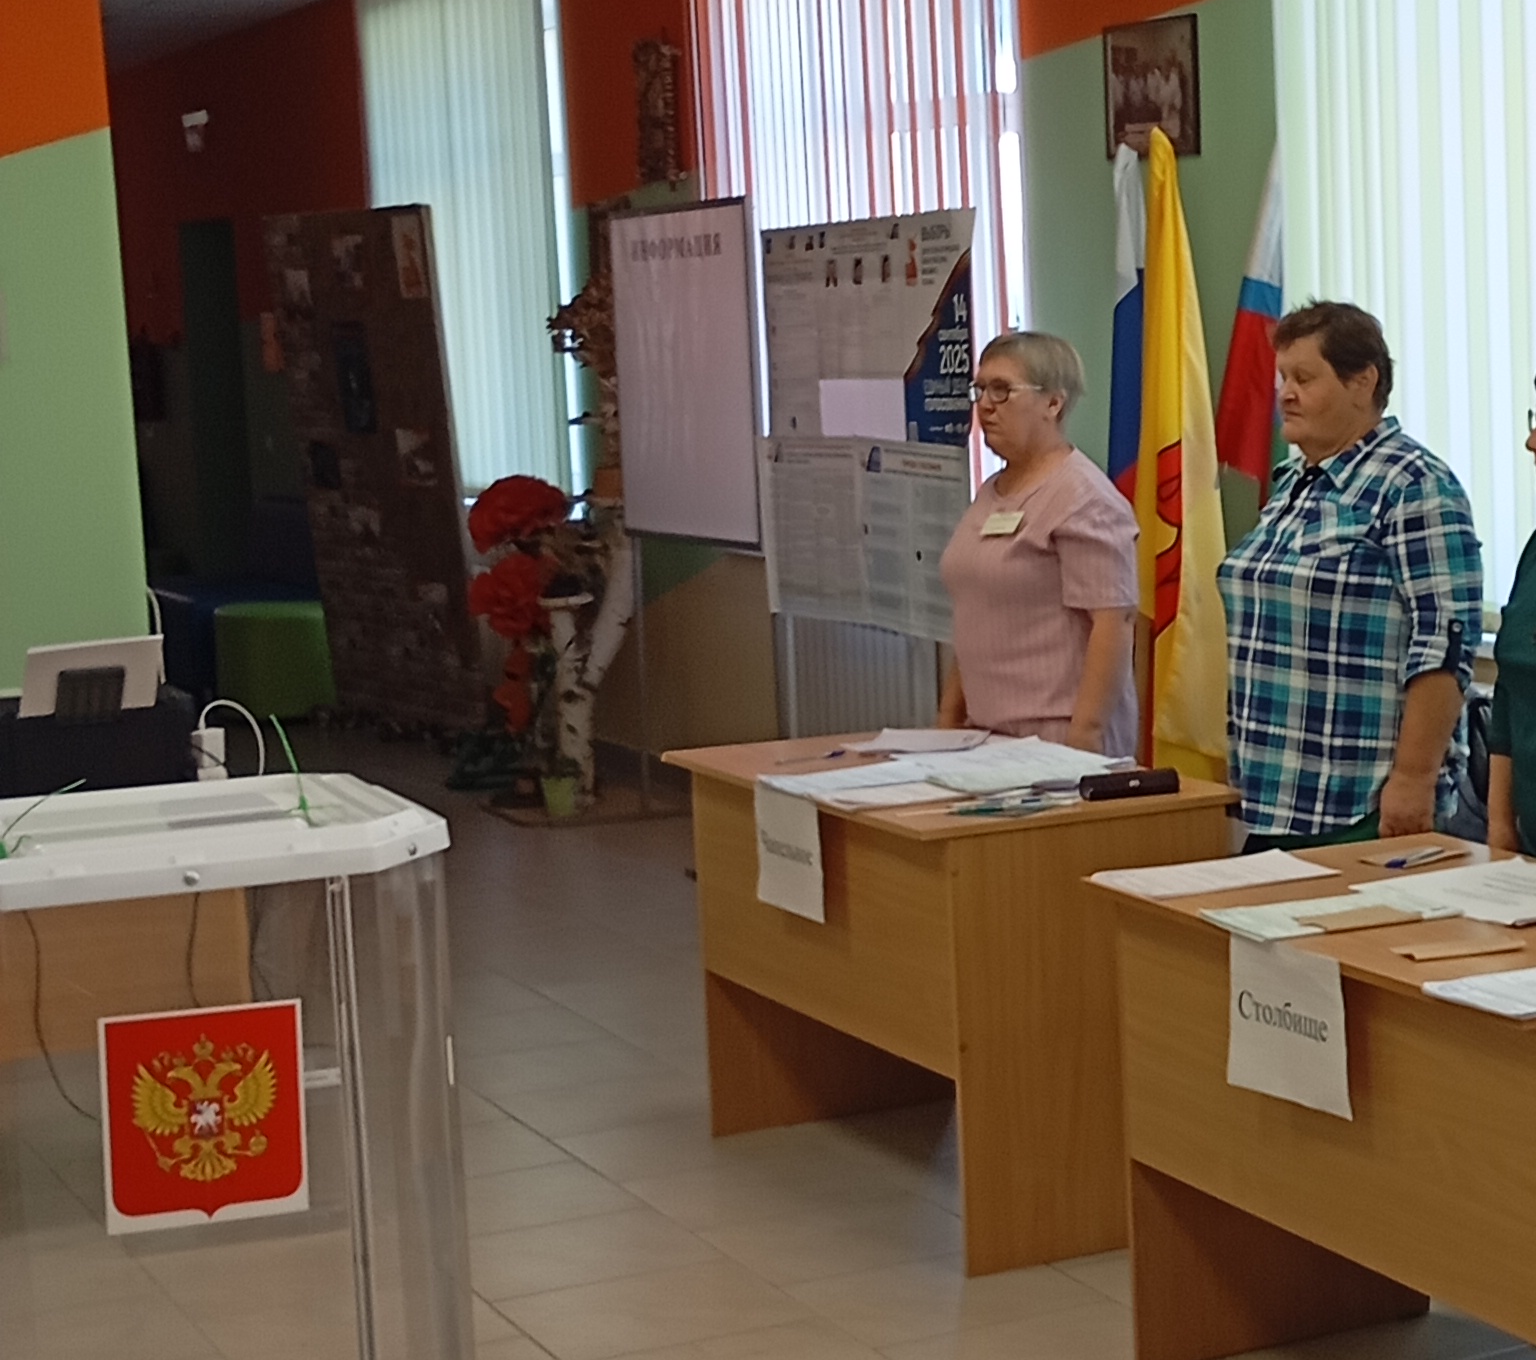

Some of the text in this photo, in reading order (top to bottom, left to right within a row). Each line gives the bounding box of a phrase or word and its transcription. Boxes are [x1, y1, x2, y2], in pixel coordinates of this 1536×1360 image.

[631, 232, 721, 261] ИНФОРМАЦИЯ
[953, 293, 967, 323] 14
[939, 344, 970, 374] 2025
[1238, 989, 1328, 1043] Столбище
